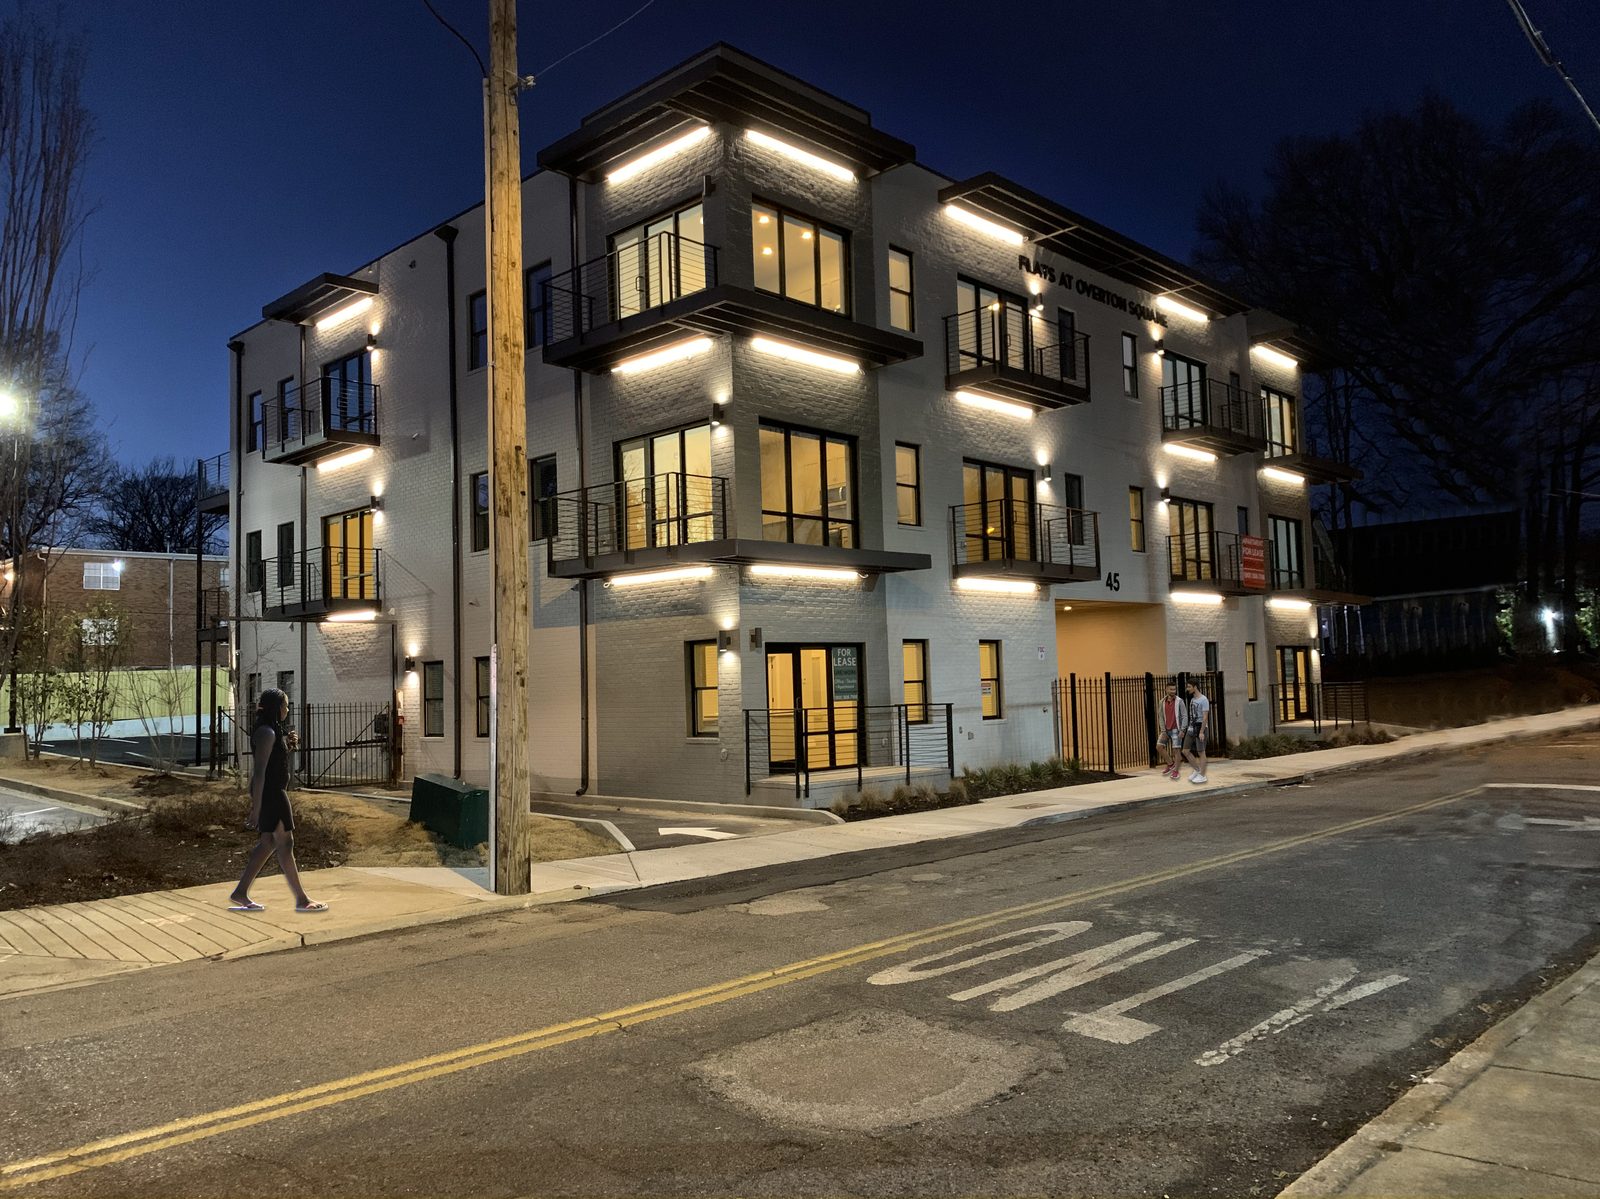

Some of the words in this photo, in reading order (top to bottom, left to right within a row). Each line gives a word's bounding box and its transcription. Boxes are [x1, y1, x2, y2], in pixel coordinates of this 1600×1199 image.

[1018, 255, 1056, 283] FLATS
[1058, 271, 1074, 290] AT
[1075, 278, 1127, 313] OVERTON
[1105, 571, 1120, 592] 45
[833, 657, 857, 667] LEASE
[837, 648, 851, 657] FOR
[866, 919, 1410, 1067] ONLY
